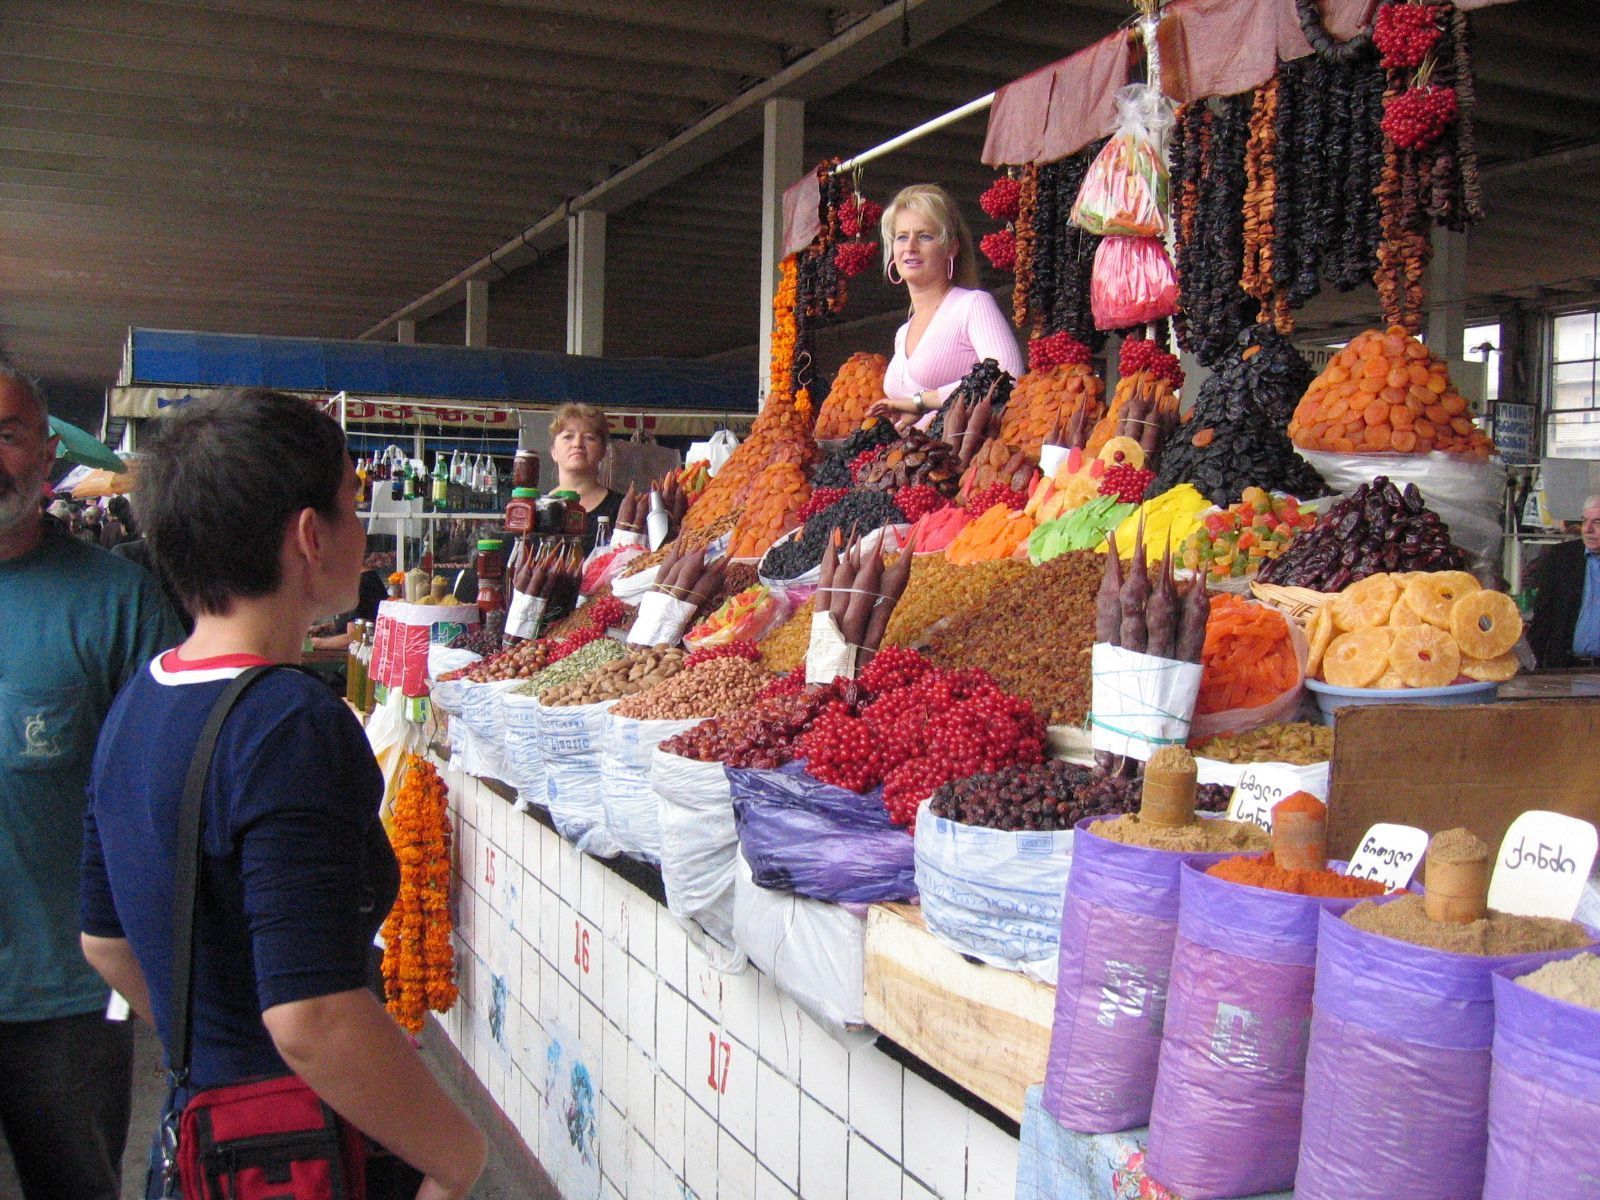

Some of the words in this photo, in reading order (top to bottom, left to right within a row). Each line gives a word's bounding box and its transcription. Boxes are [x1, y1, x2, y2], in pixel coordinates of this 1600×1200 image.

[485, 846, 495, 885] 15
[574, 920, 590, 974] 16
[707, 1031, 731, 1095] 17
